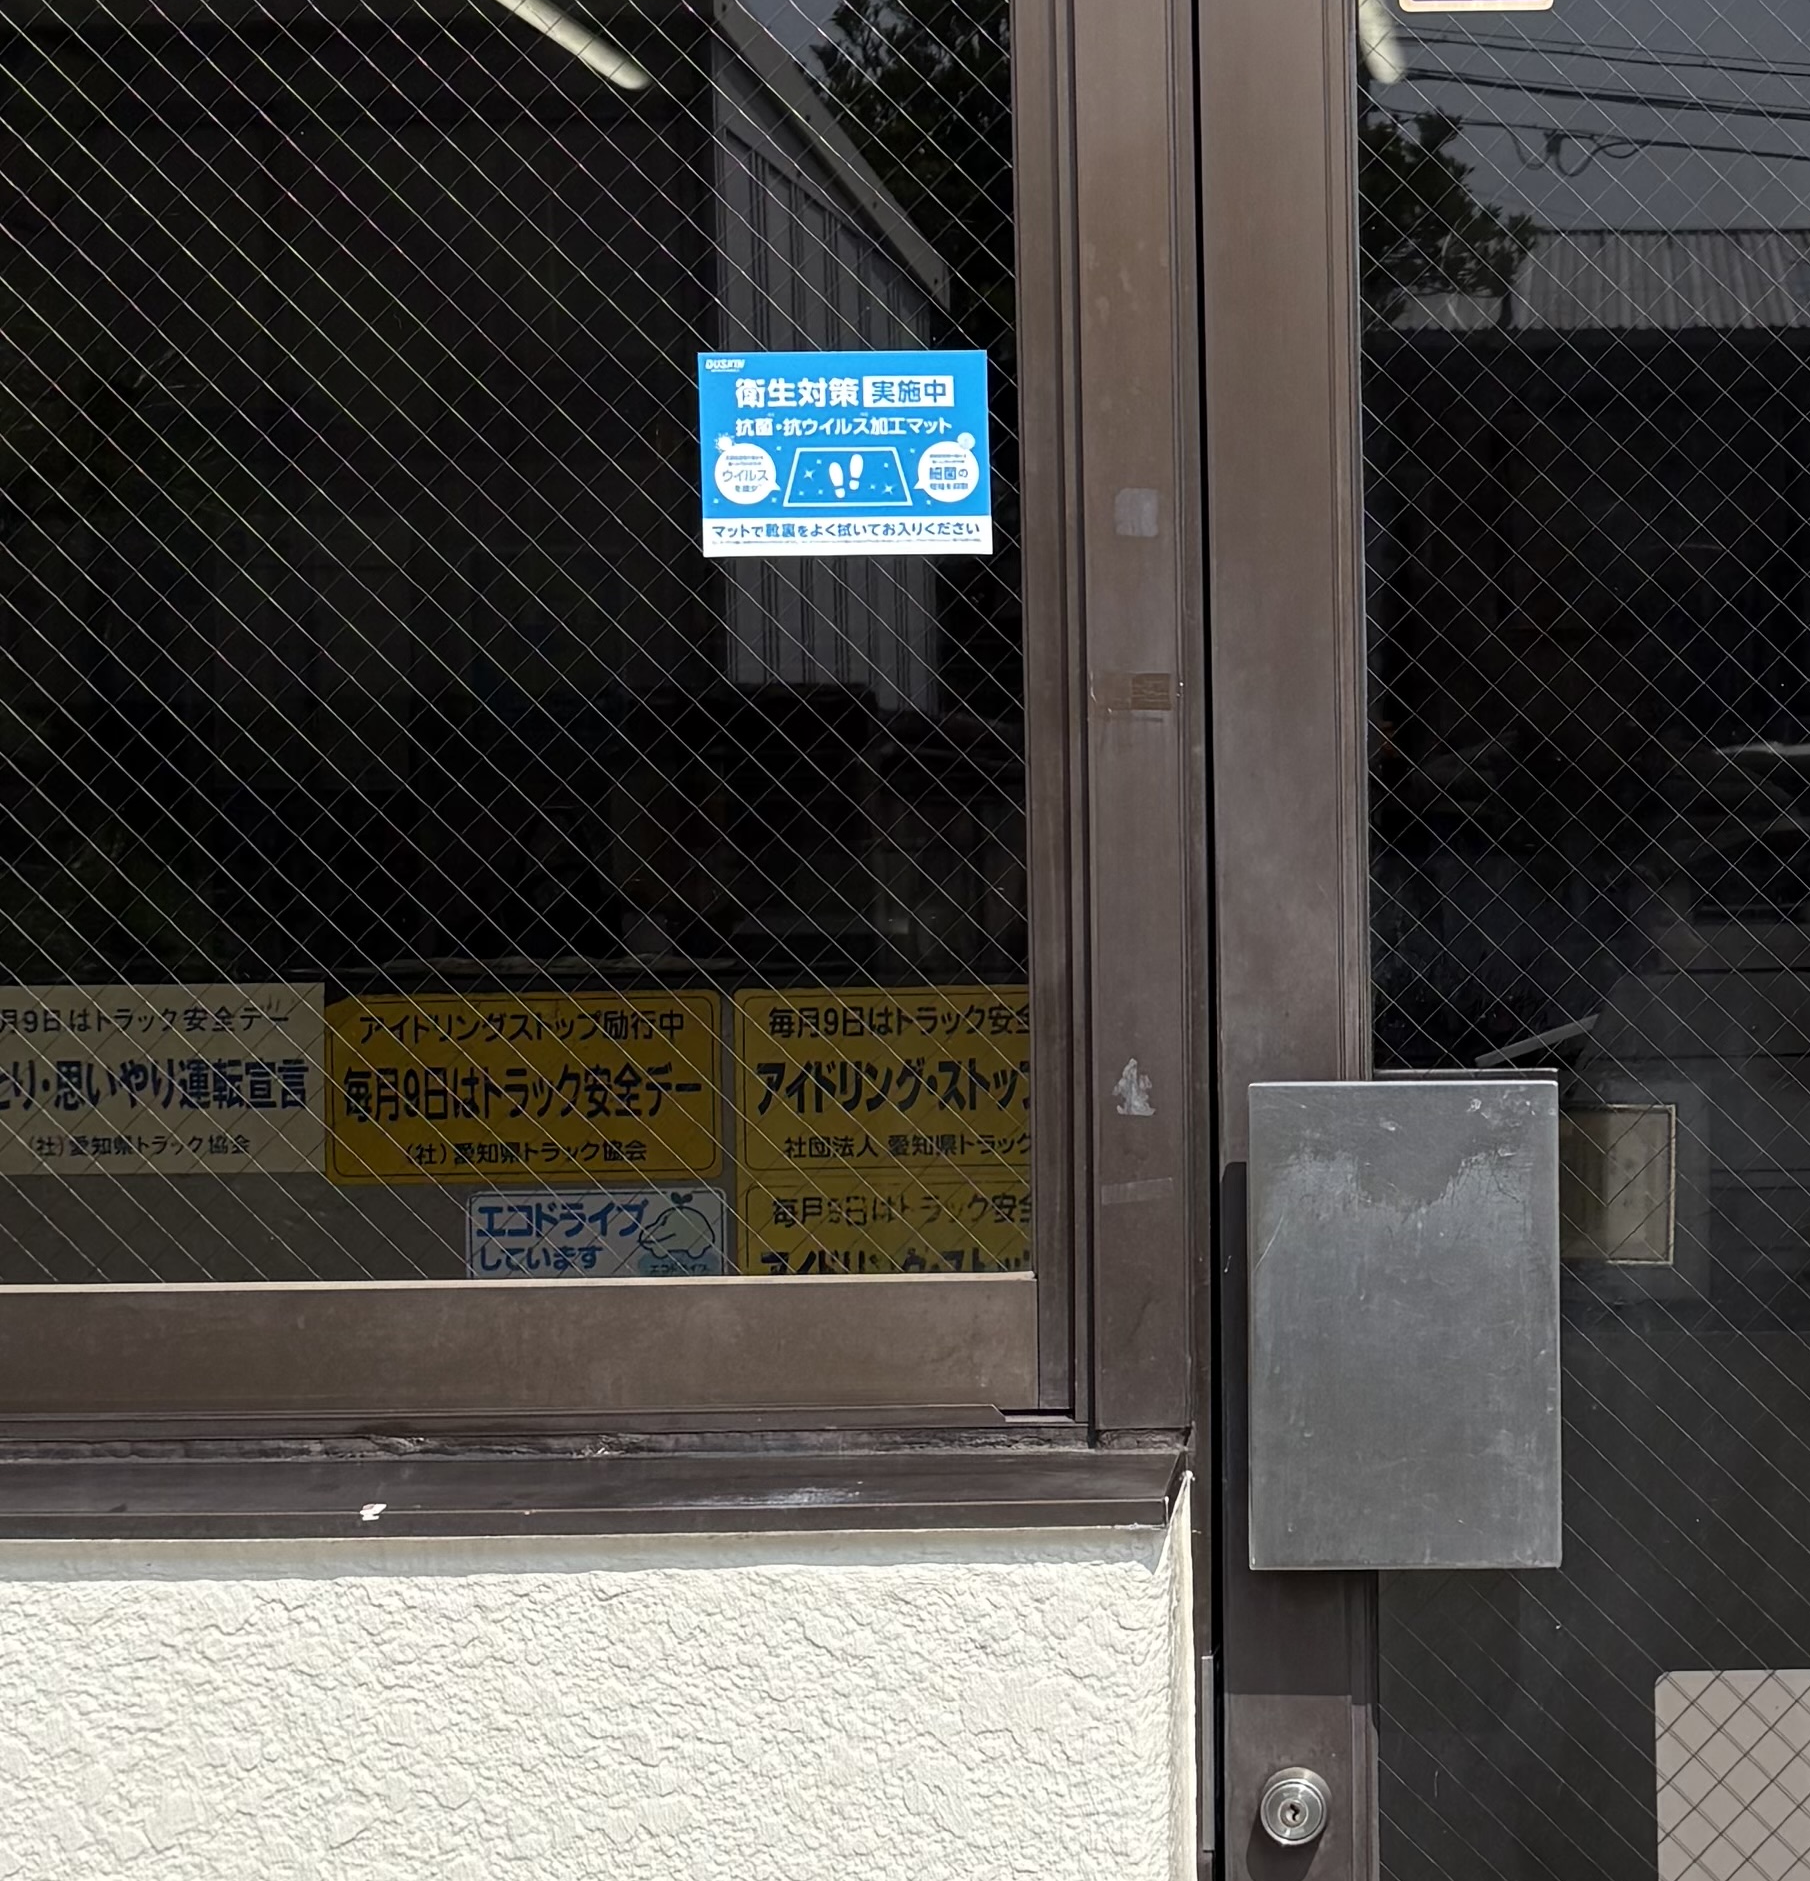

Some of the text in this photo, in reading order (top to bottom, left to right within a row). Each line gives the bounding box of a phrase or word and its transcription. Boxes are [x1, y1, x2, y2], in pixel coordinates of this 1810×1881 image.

[735, 377, 947, 409] 衛生対策 実施中
[722, 469, 769, 482] ウイルス
[344, 1061, 703, 1122] 毎月9日はトラック安全デー
[784, 1134, 878, 1160] 社団法人
[481, 1245, 603, 1272] しています
